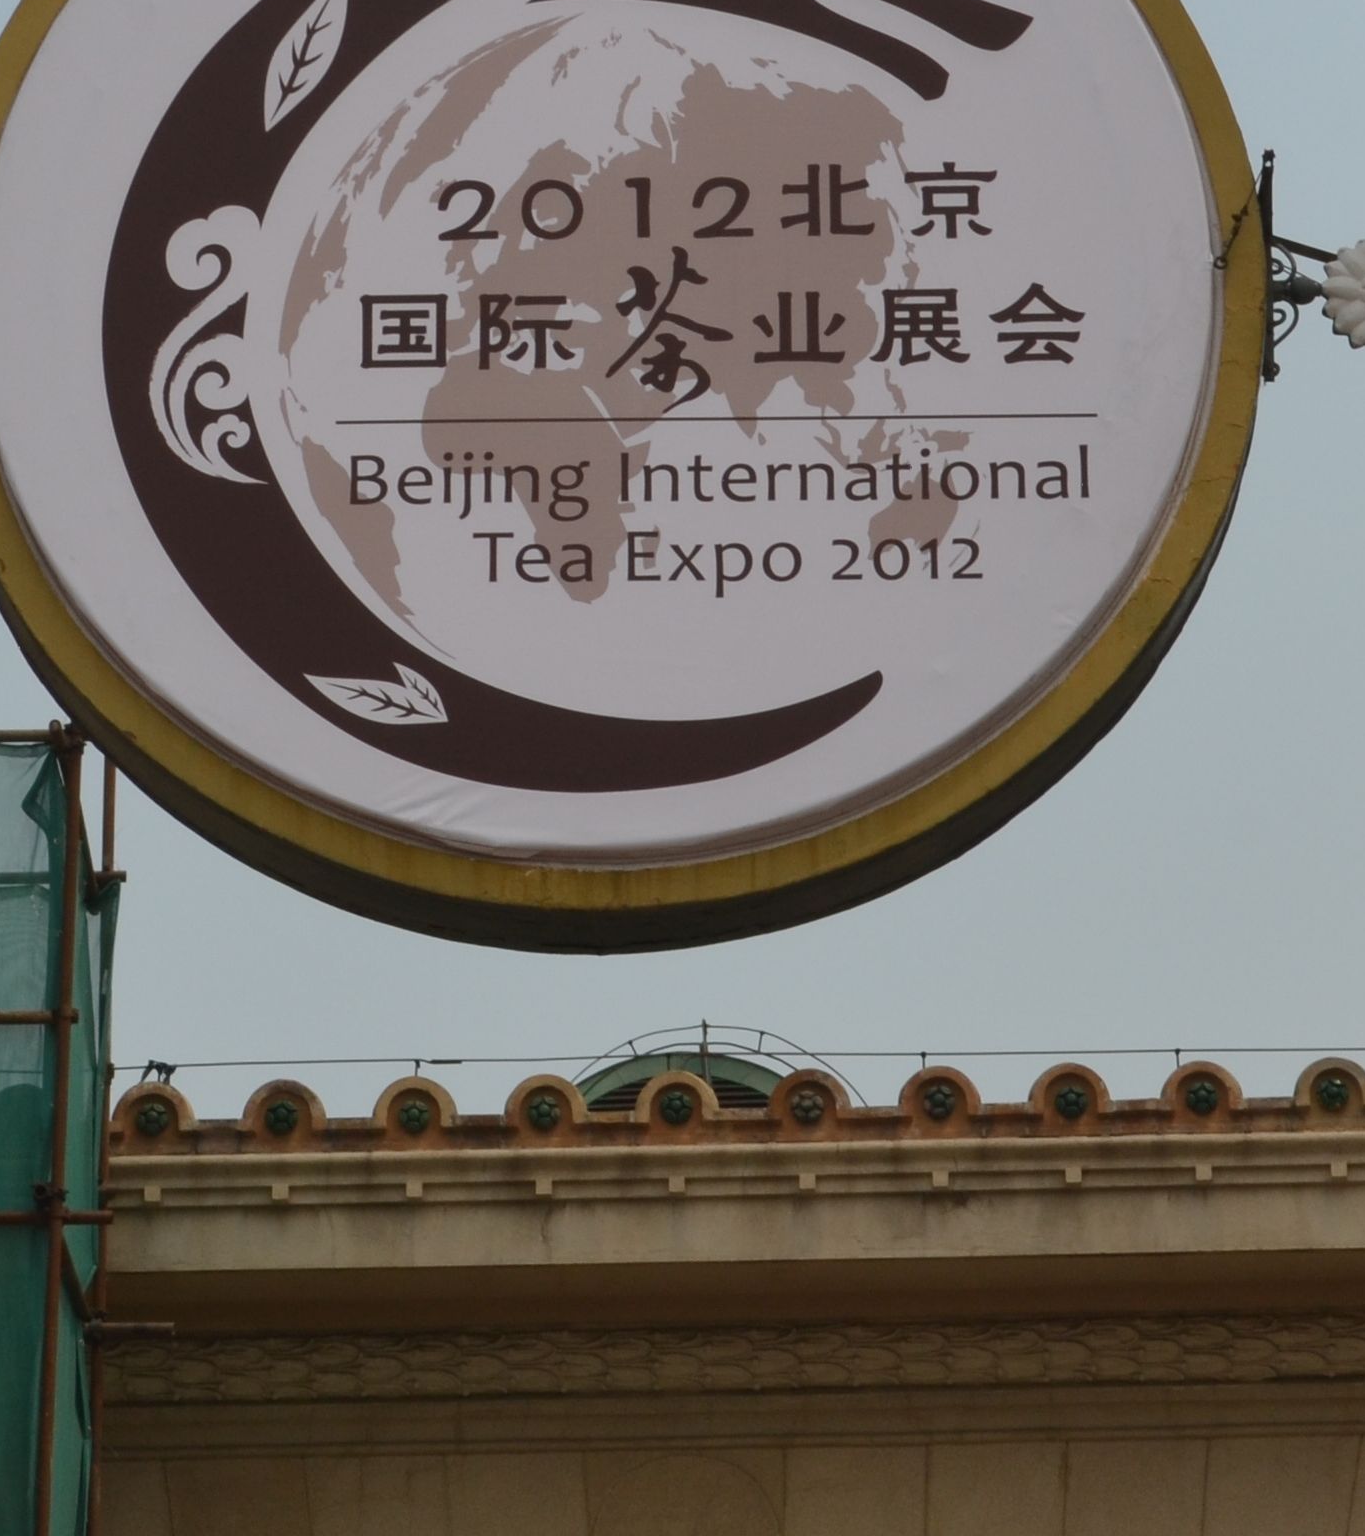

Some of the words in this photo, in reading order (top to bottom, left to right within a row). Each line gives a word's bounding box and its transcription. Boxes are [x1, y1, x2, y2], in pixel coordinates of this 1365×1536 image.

[358, 245, 1086, 414] 国际茶业展会
[348, 451, 591, 522] Beijing
[619, 444, 1091, 502] International
[473, 531, 594, 583] Tea
[626, 531, 803, 598] Expo
[830, 536, 984, 581] 2012
